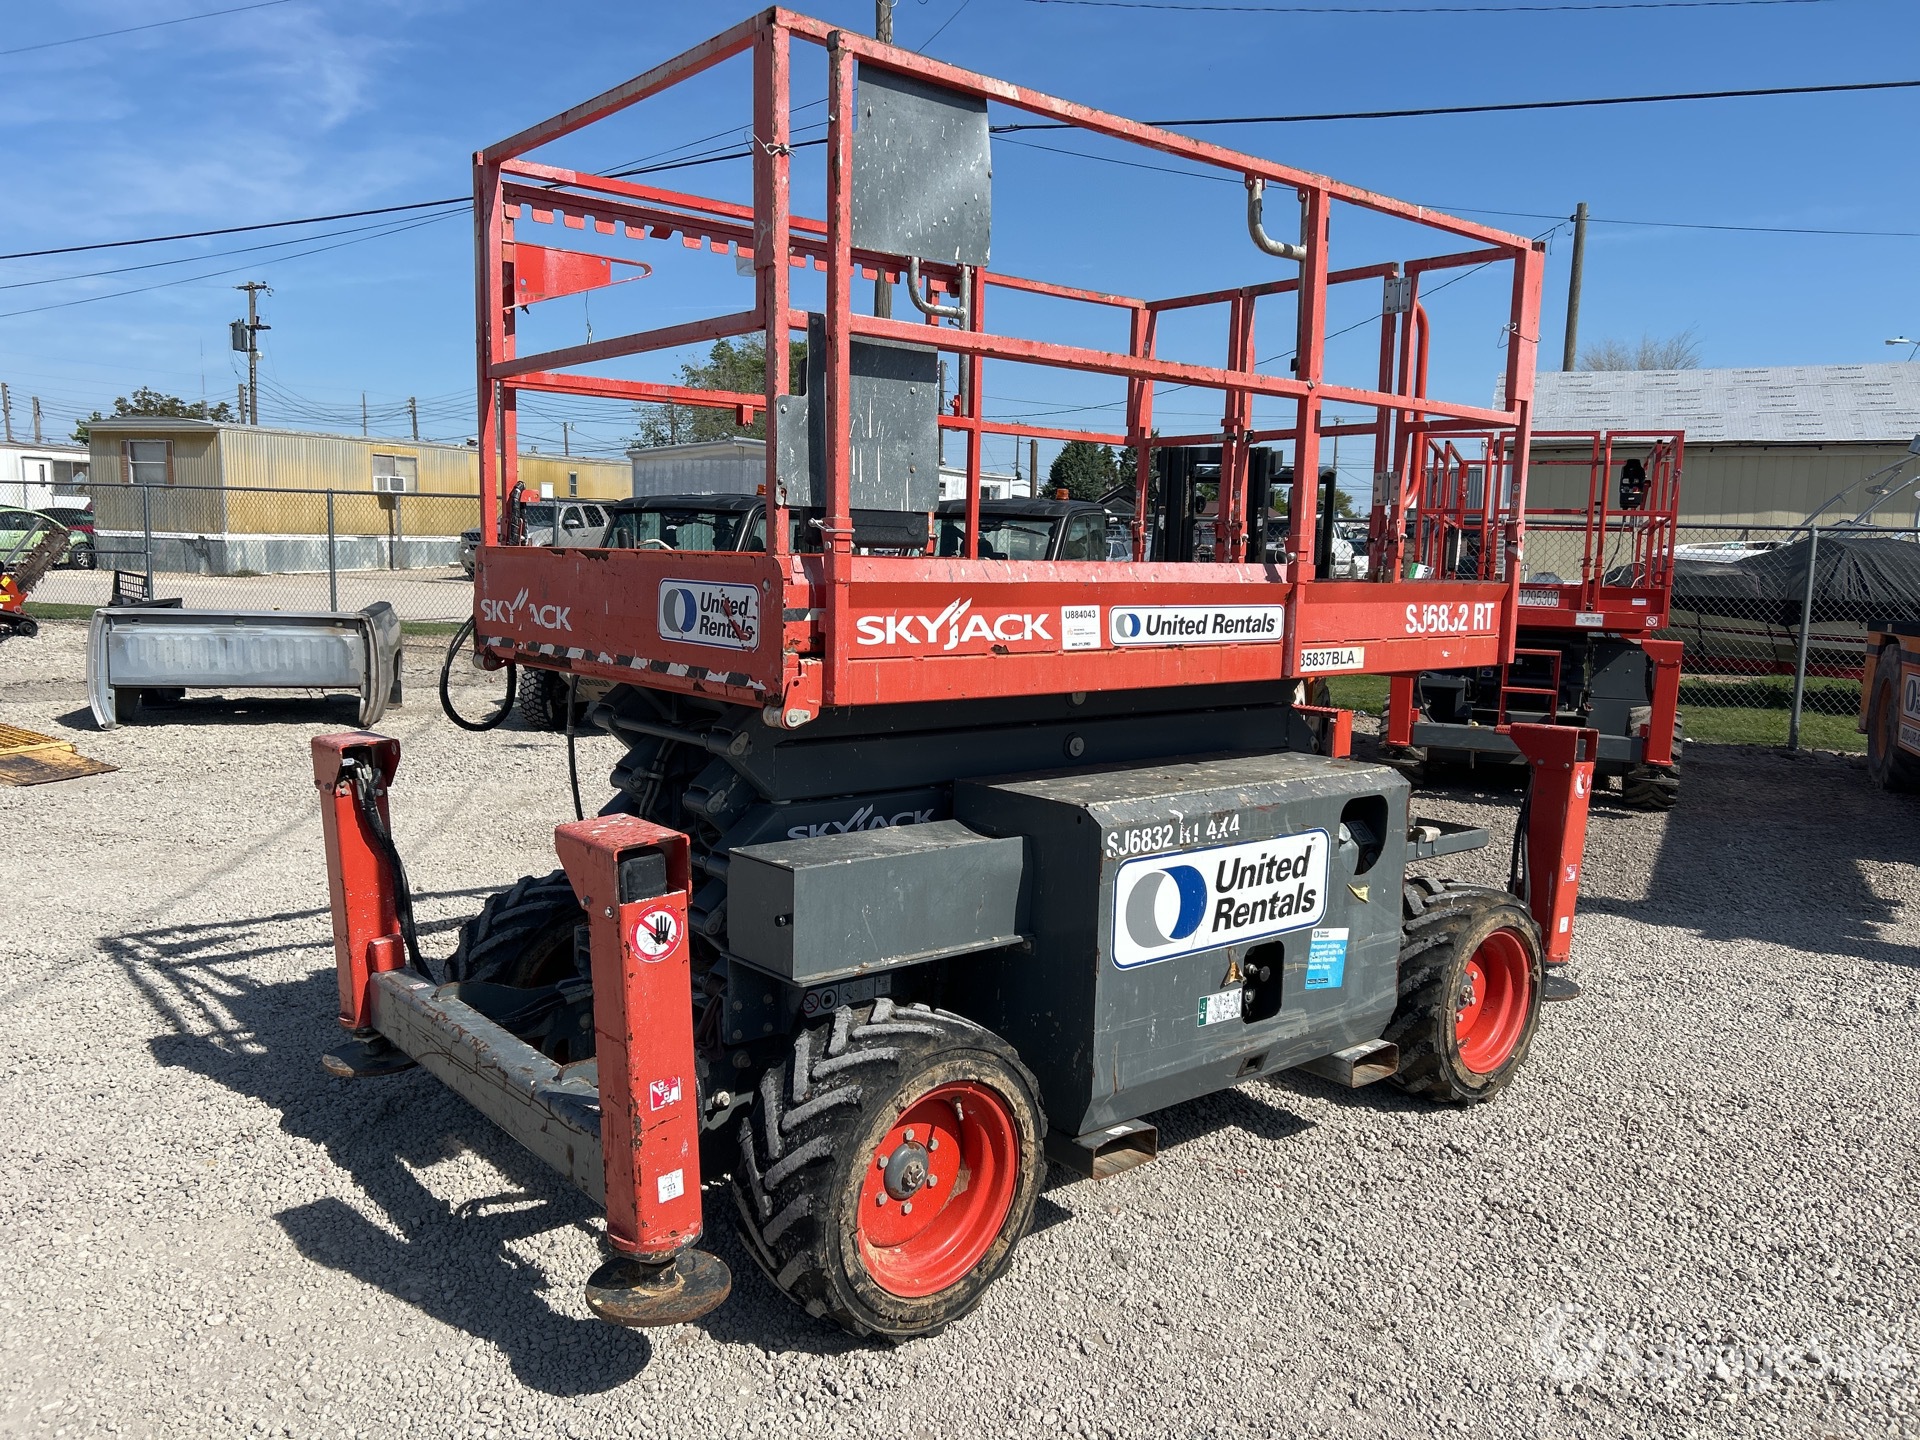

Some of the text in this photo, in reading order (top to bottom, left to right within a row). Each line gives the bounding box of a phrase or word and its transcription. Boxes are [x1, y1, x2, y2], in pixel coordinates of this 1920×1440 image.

[856, 597, 1053, 650] SKYJACK
[1065, 610, 1096, 619] U884043
[1145, 611, 1276, 636] United Rentals
[1473, 602, 1495, 631] RT
[787, 803, 935, 839] SKYJACK
[1106, 824, 1174, 858] SJ6832
[1215, 845, 1313, 894] United
[1211, 883, 1317, 933] Rentals
